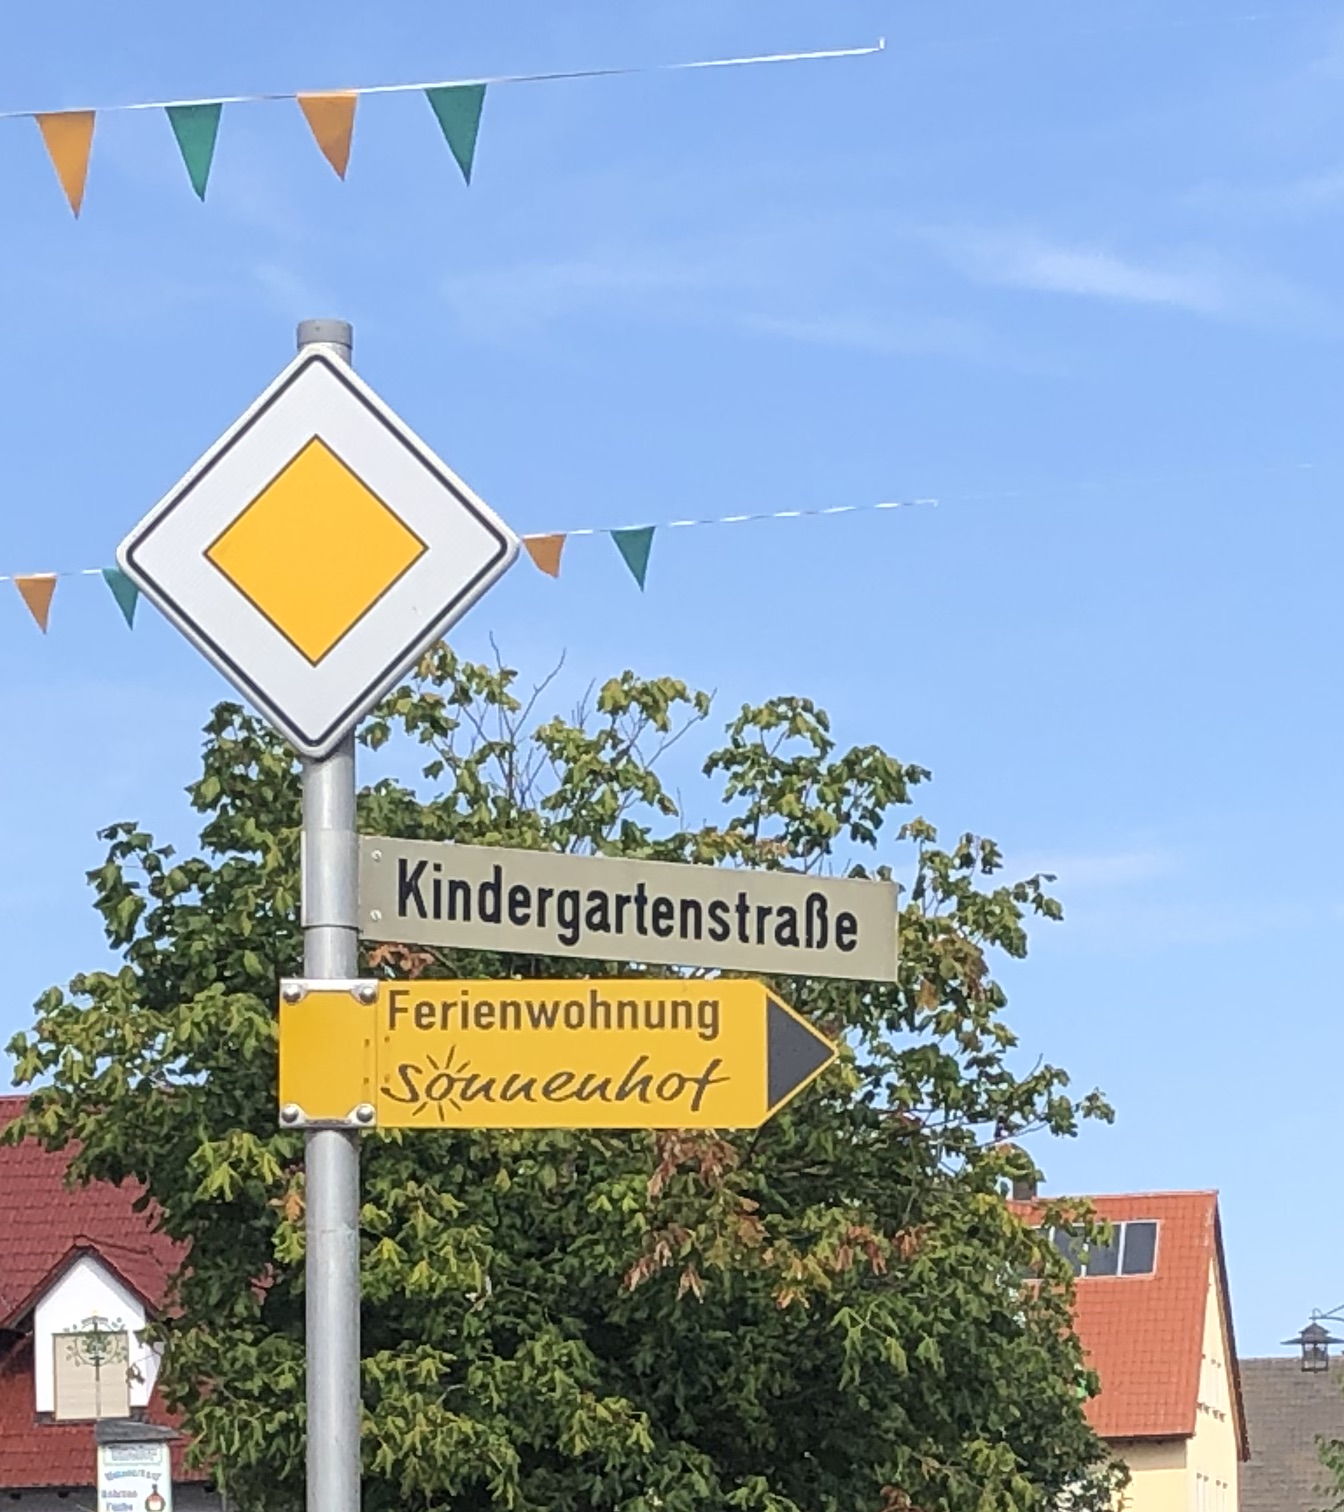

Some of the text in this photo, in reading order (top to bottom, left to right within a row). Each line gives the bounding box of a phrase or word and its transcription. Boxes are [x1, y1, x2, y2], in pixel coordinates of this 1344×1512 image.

[397, 857, 859, 953] Kindergartenstraße
[387, 988, 720, 1039] Ferienwohnung
[380, 1054, 731, 1112] Sonnenhof
